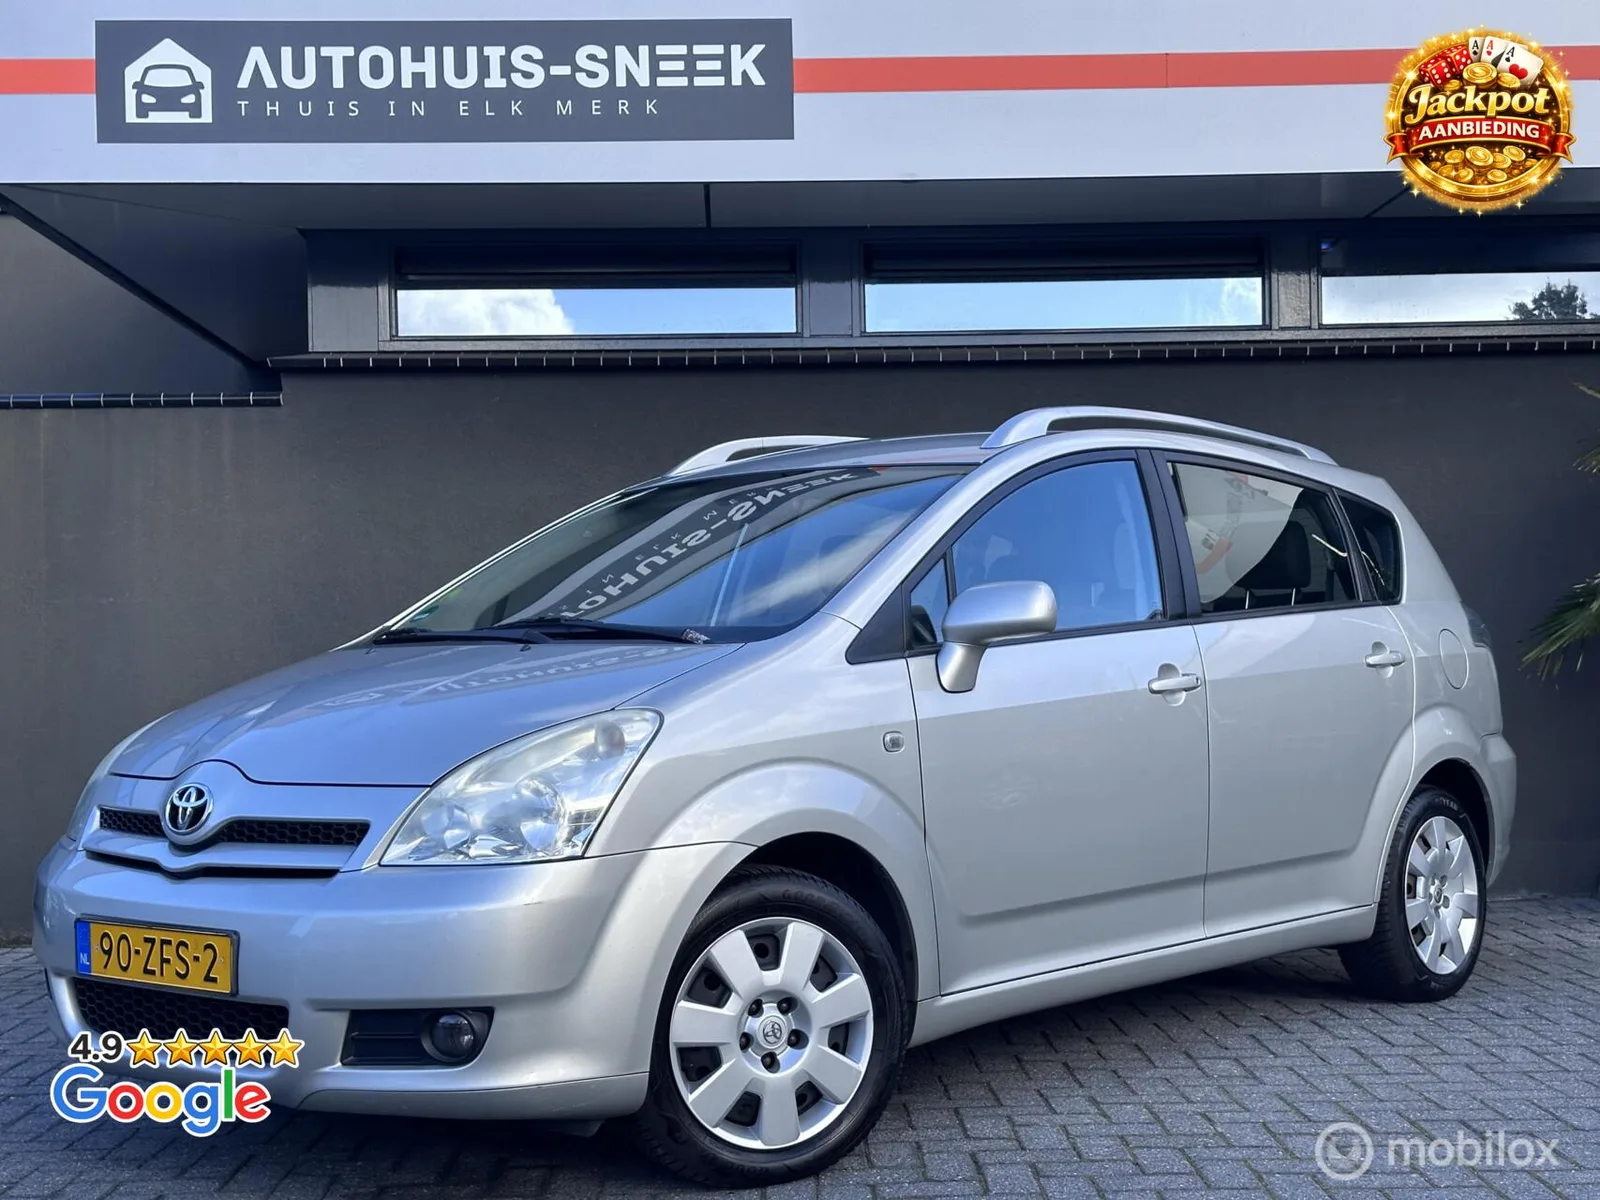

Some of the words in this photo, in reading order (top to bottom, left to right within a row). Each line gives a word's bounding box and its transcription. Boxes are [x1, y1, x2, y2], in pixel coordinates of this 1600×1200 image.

[237, 43, 766, 90] AUTOHUIS-SNEEK
[236, 101, 359, 117] THUIS
[388, 101, 425, 117] IN
[459, 100, 523, 116] ELK
[556, 99, 658, 116] MERK
[79, 953, 90, 966] NL
[99, 931, 219, 984] 90-ZFS-2
